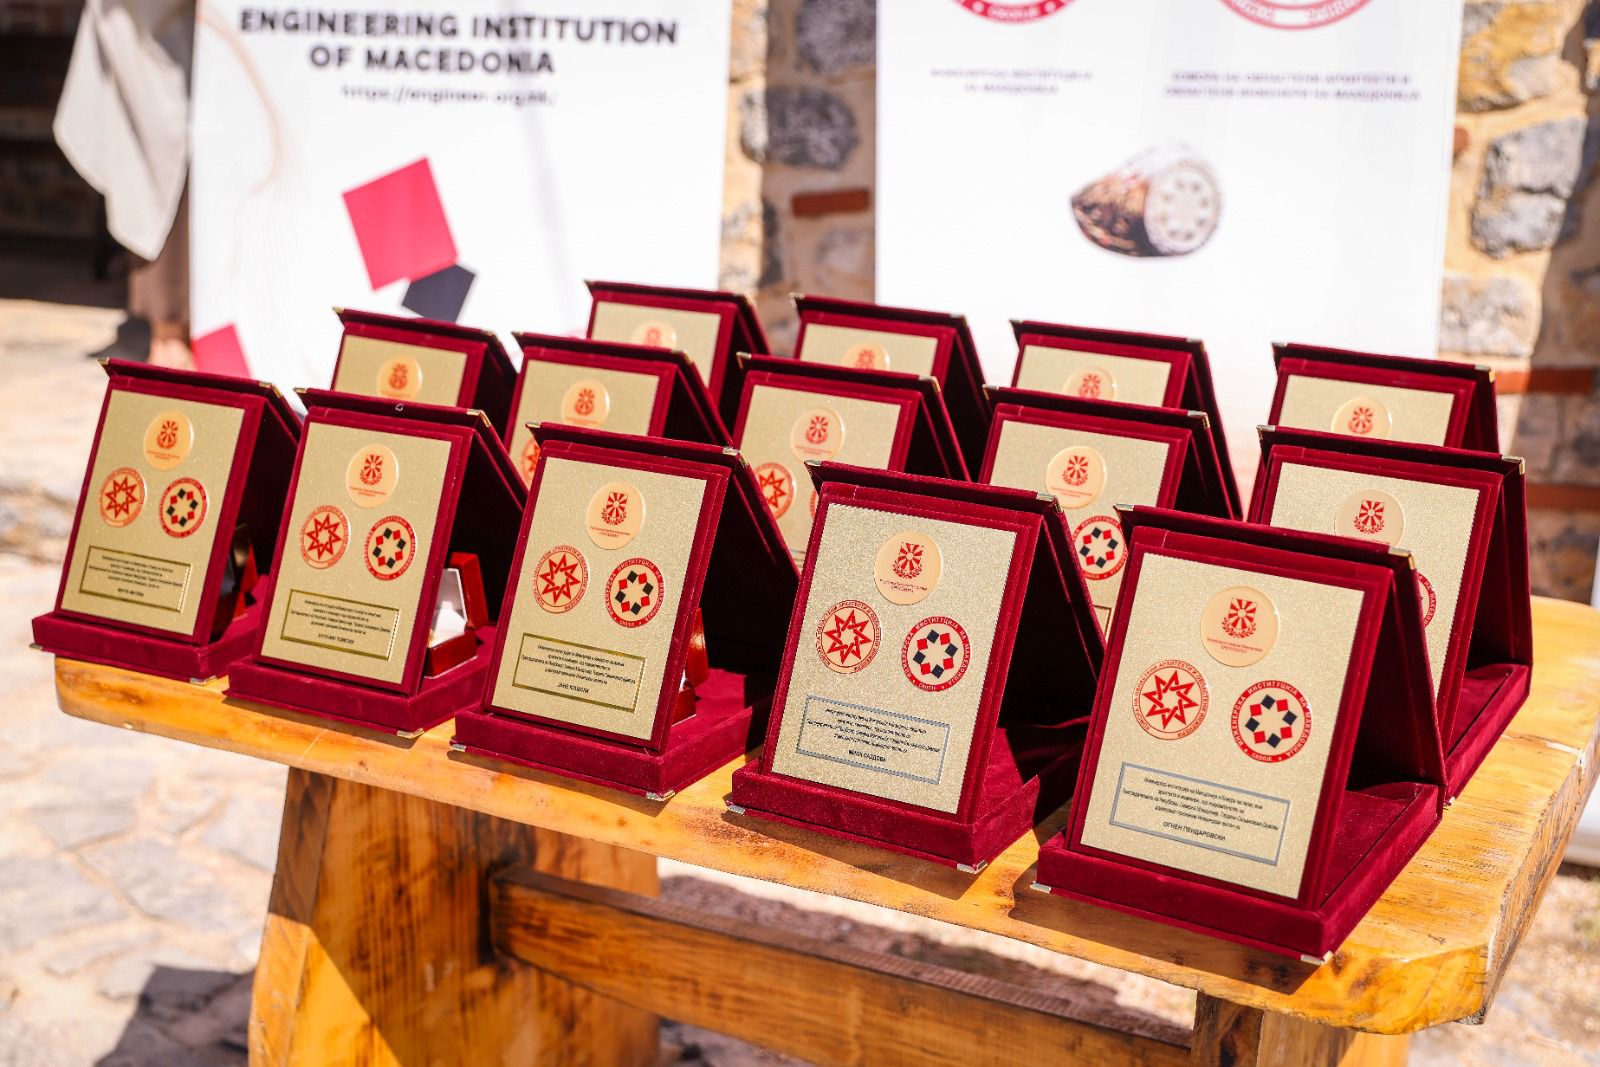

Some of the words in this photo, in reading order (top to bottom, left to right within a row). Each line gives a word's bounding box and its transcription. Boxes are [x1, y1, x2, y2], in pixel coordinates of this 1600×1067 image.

[240, 10, 458, 38] ENGINEERING
[472, 16, 679, 44] INSTITUTION
[310, 46, 351, 69] OF
[365, 48, 555, 75] MACEDONIA
